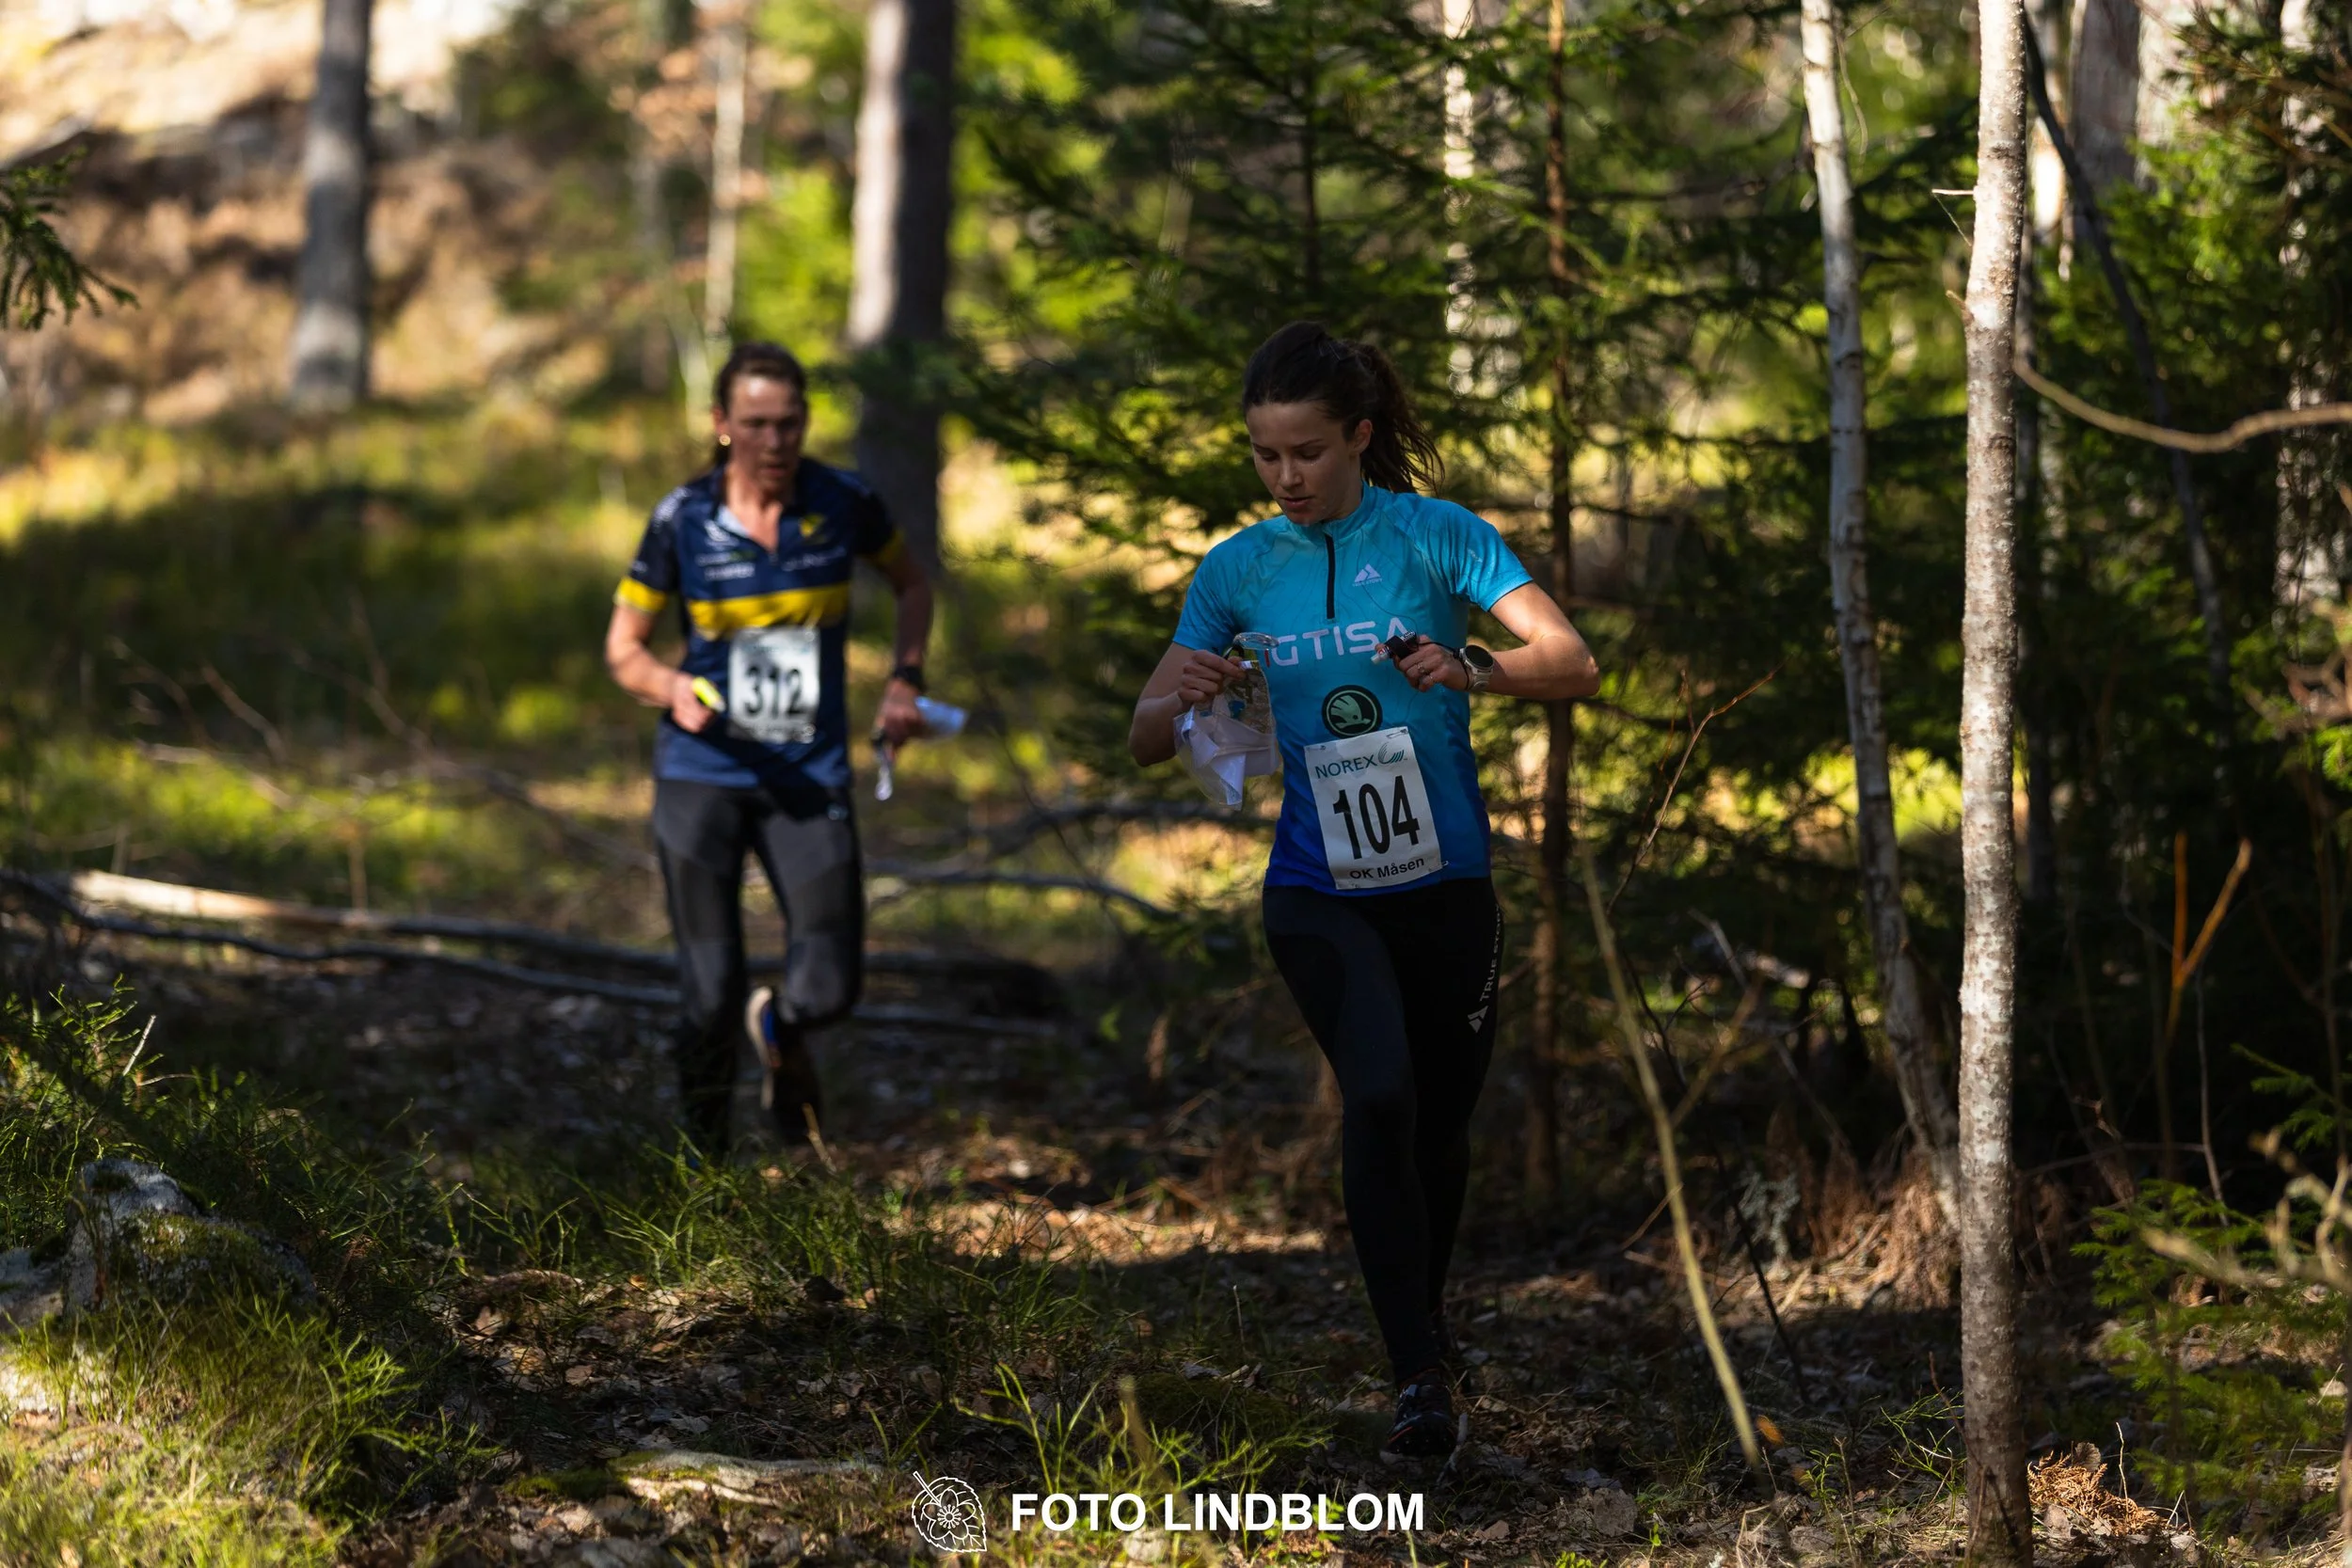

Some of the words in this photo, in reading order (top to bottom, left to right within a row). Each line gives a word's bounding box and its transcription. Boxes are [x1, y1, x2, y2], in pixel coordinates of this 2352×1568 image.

[745, 664, 803, 719] 312
[1315, 754, 1377, 779] NOREX
[1332, 775, 1421, 860] 104
[1349, 869, 1374, 879] OK
[1377, 858, 1424, 879] Måsen
[1479, 958, 1498, 1002] TRUE
